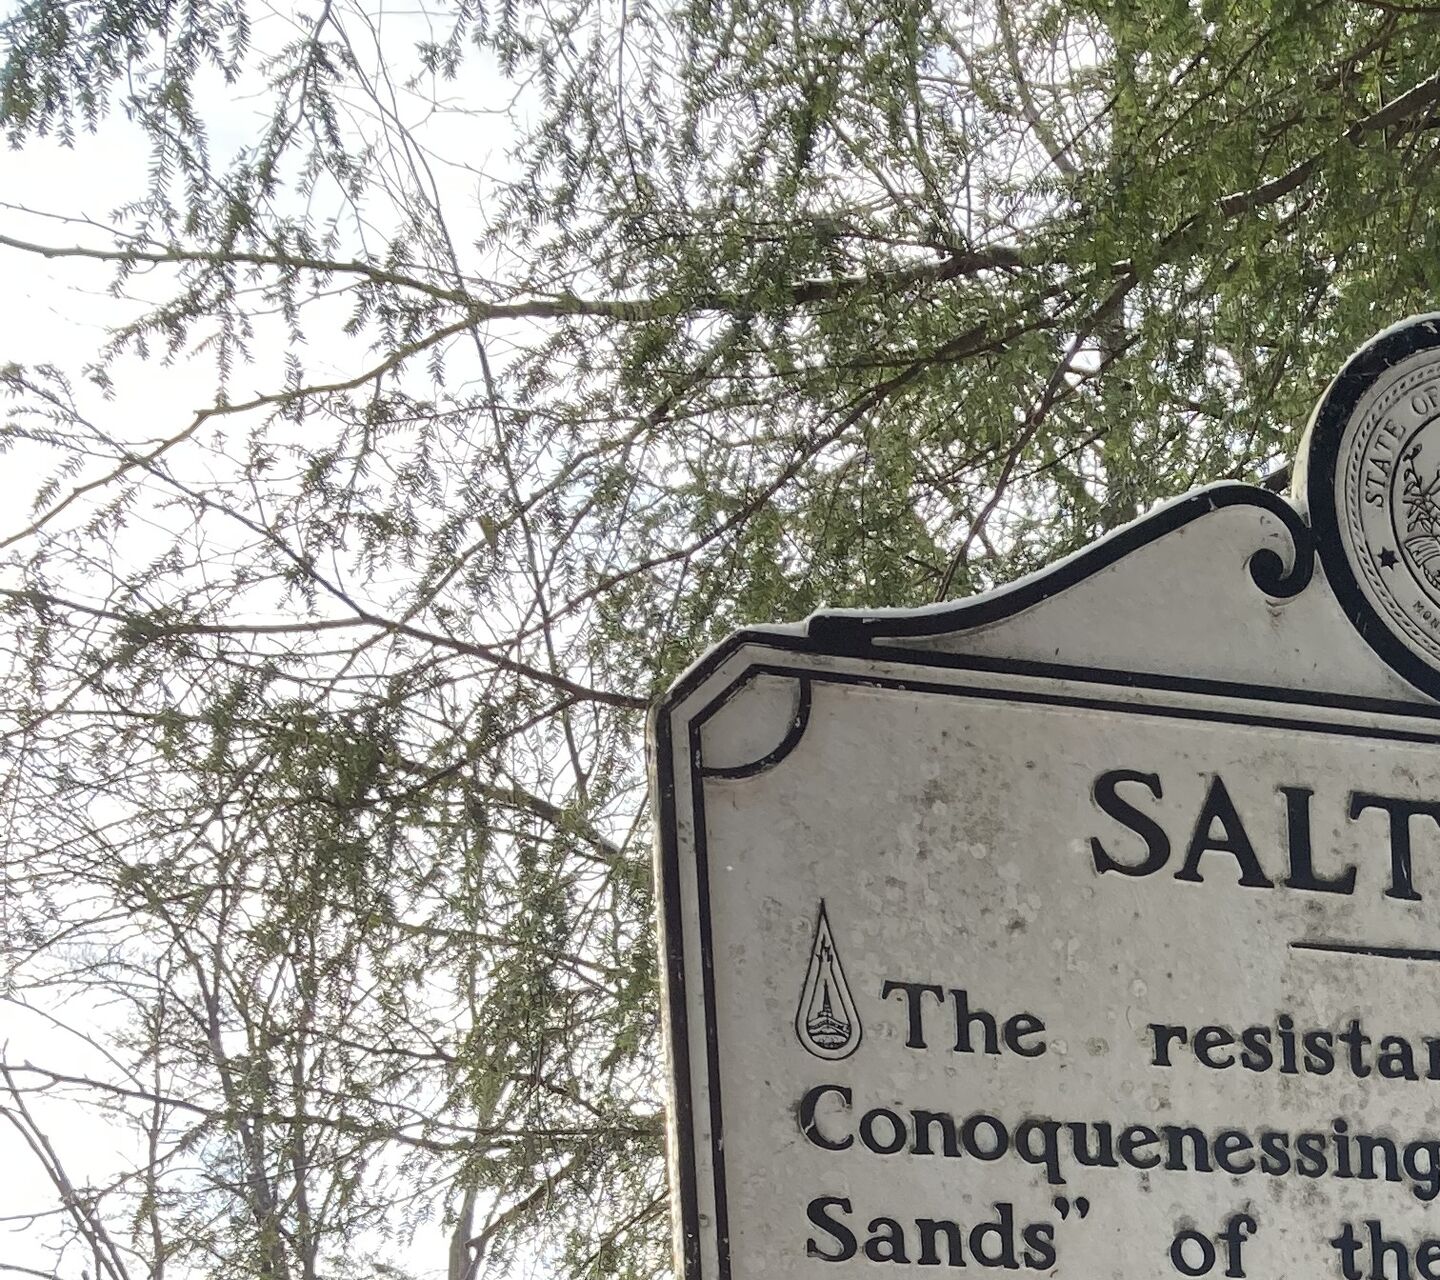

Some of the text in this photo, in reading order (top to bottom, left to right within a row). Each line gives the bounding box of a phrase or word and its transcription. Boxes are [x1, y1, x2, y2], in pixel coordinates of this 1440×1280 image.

[1365, 418, 1407, 508] STATE
[1411, 385, 1439, 416] OF
[883, 980, 1046, 1057] The
[800, 1084, 1440, 1200] Conoquenessing
[1170, 1213, 1256, 1279] of
